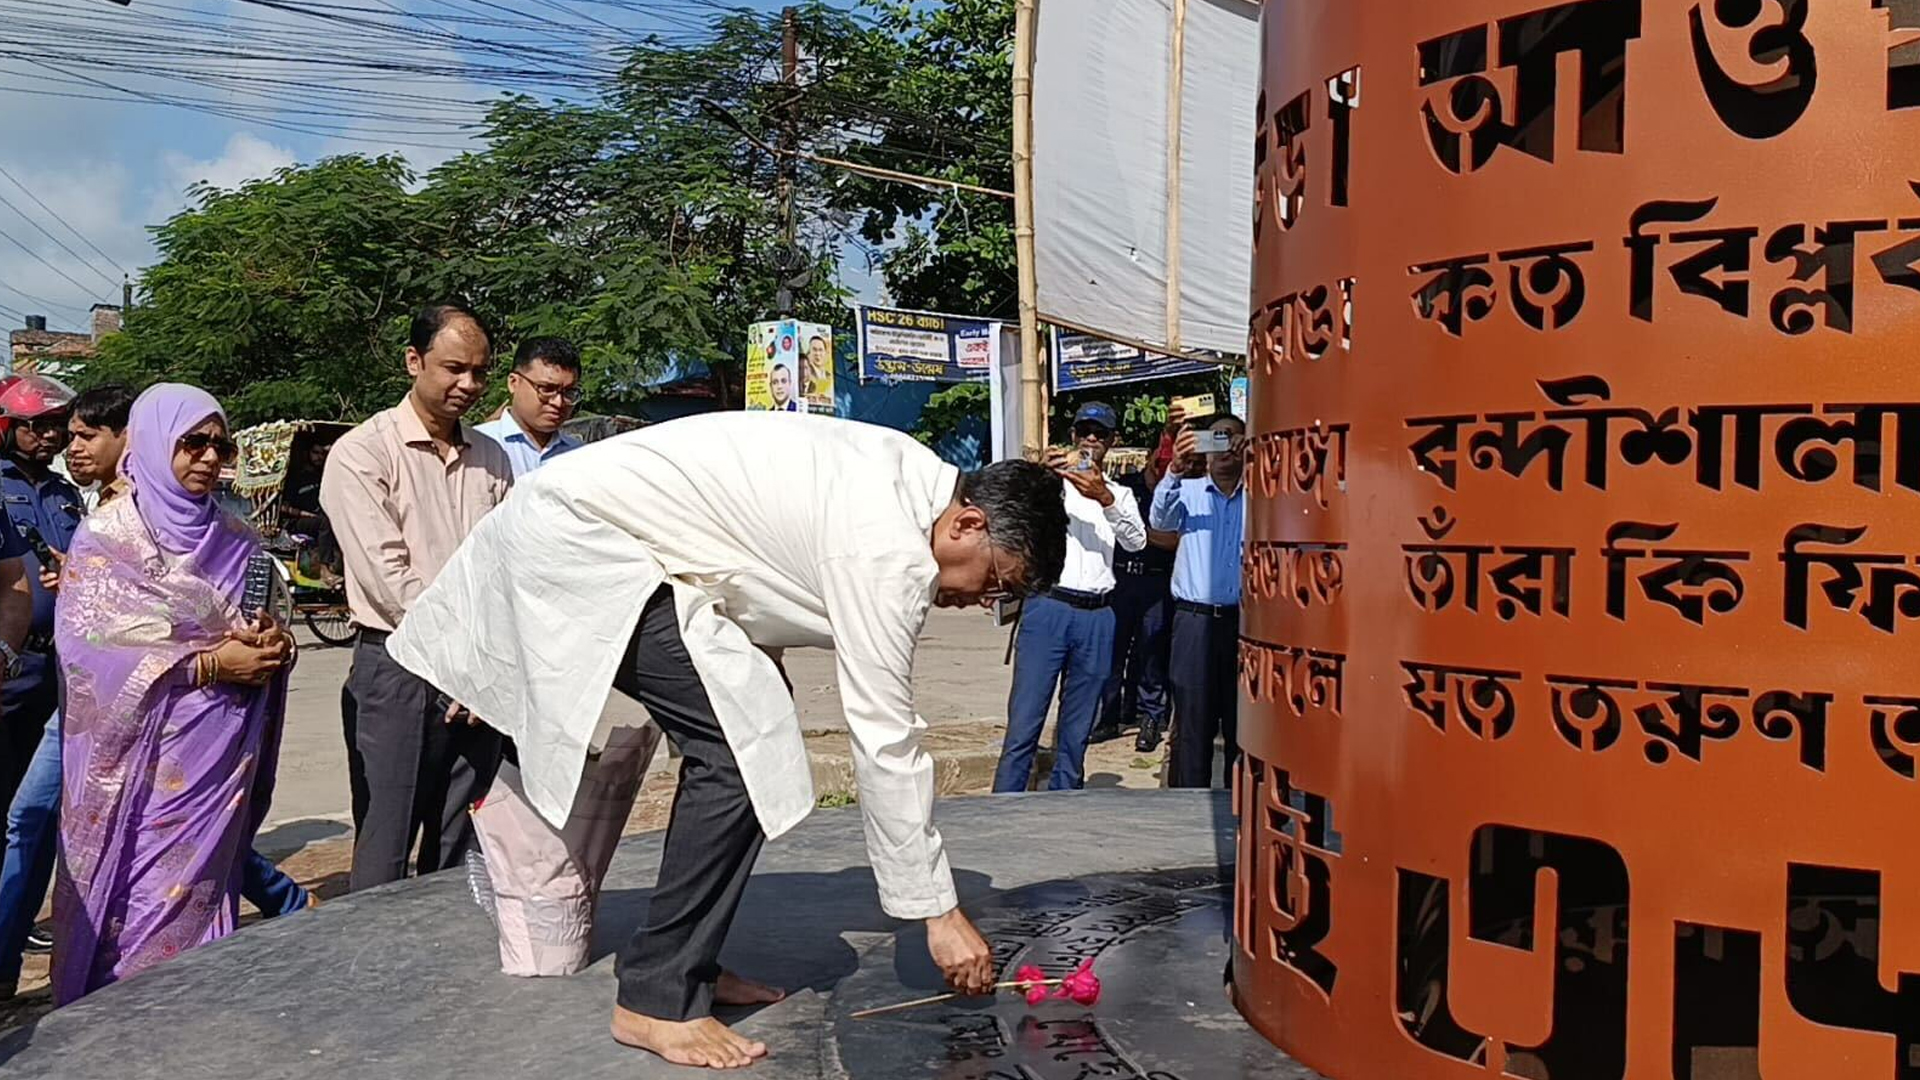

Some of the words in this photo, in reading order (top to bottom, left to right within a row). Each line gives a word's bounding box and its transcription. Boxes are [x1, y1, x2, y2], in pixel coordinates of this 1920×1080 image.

[1409, 240, 1593, 336] কত
[1623, 181, 1920, 336] বিপ্লব
[866, 309, 894, 325] HSC
[897, 312, 914, 327] 26
[1401, 505, 1576, 622] তাঁরা
[1602, 521, 1750, 626] কি
[1400, 660, 1522, 741] যত
[1545, 673, 1833, 772] তরুণ
